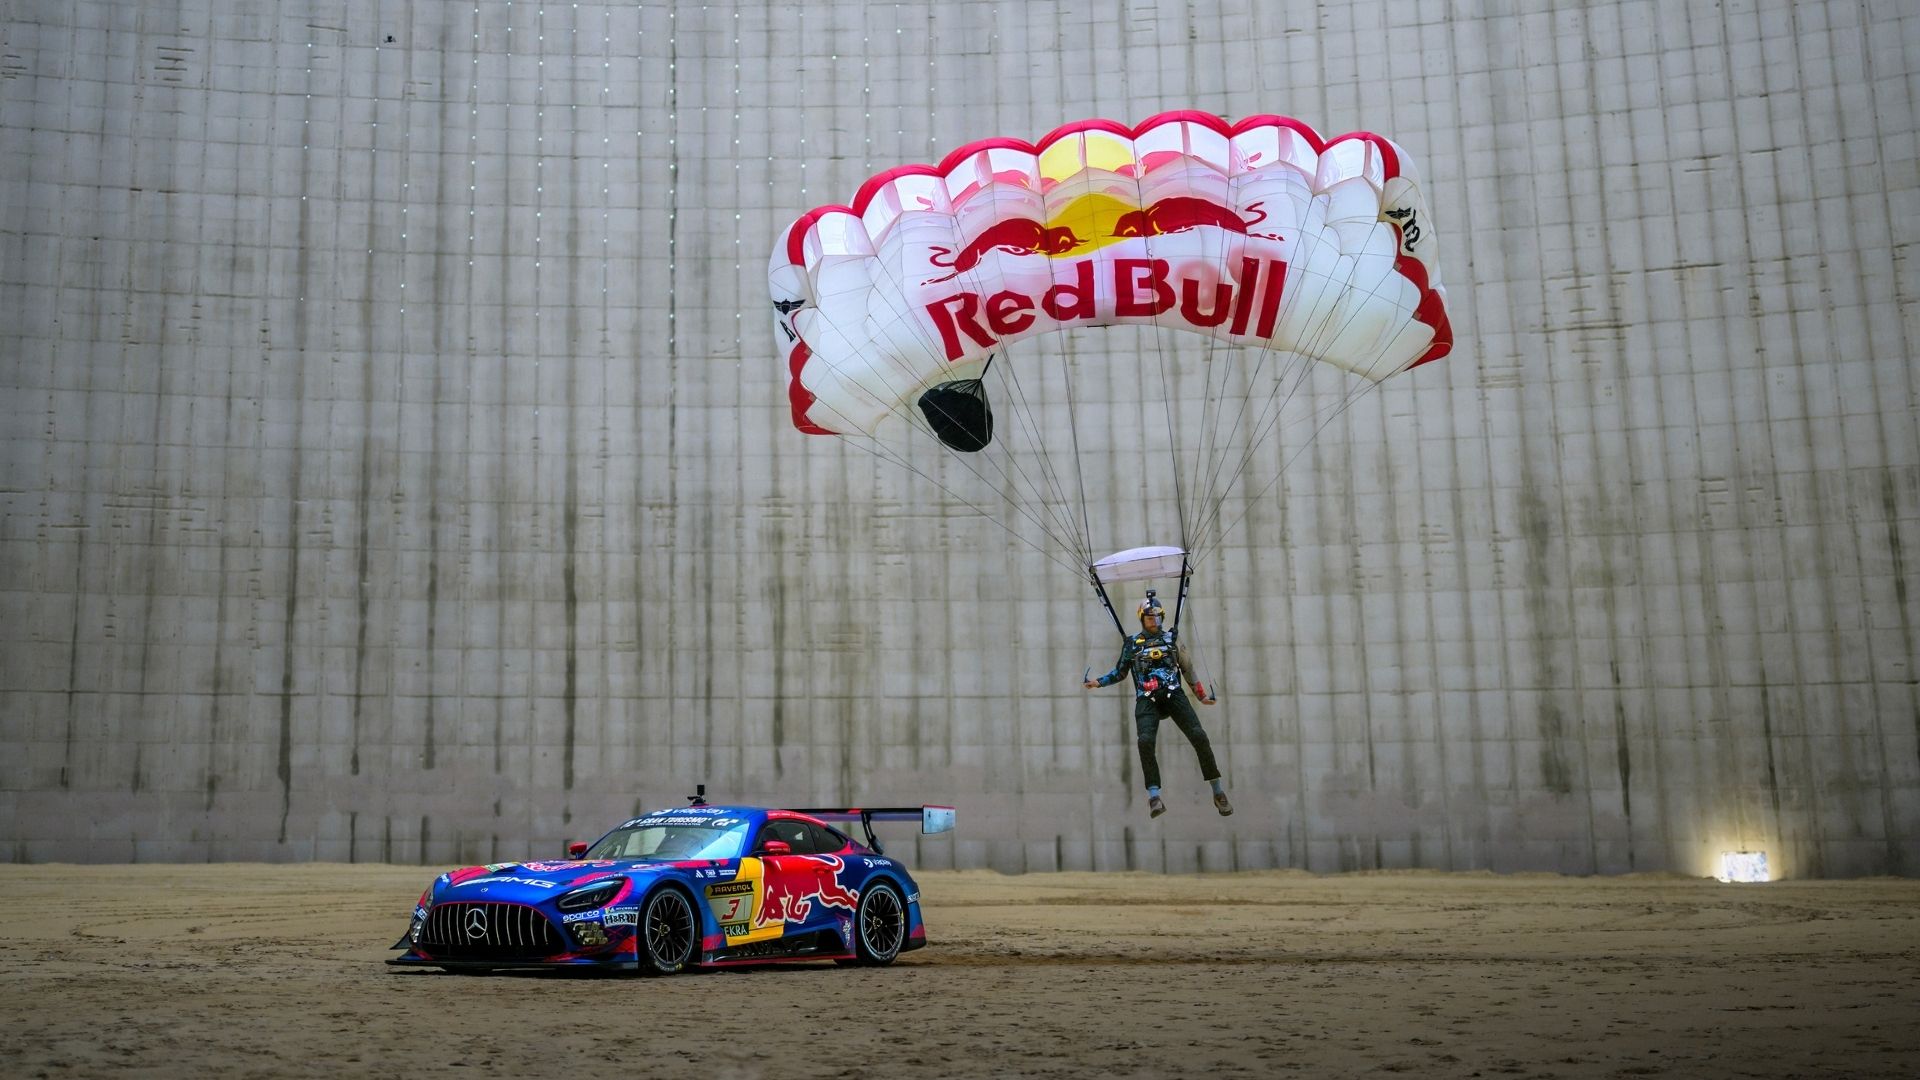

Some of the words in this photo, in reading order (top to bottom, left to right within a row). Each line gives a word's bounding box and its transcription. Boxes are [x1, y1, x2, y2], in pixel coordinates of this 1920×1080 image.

[925, 258, 1096, 362] Red
[1114, 256, 1288, 340] Bull
[453, 876, 556, 889] AMG
[714, 884, 751, 894] RAVENOL
[721, 897, 741, 920] 3
[563, 910, 600, 921] sparco
[604, 913, 626, 925] H&R
